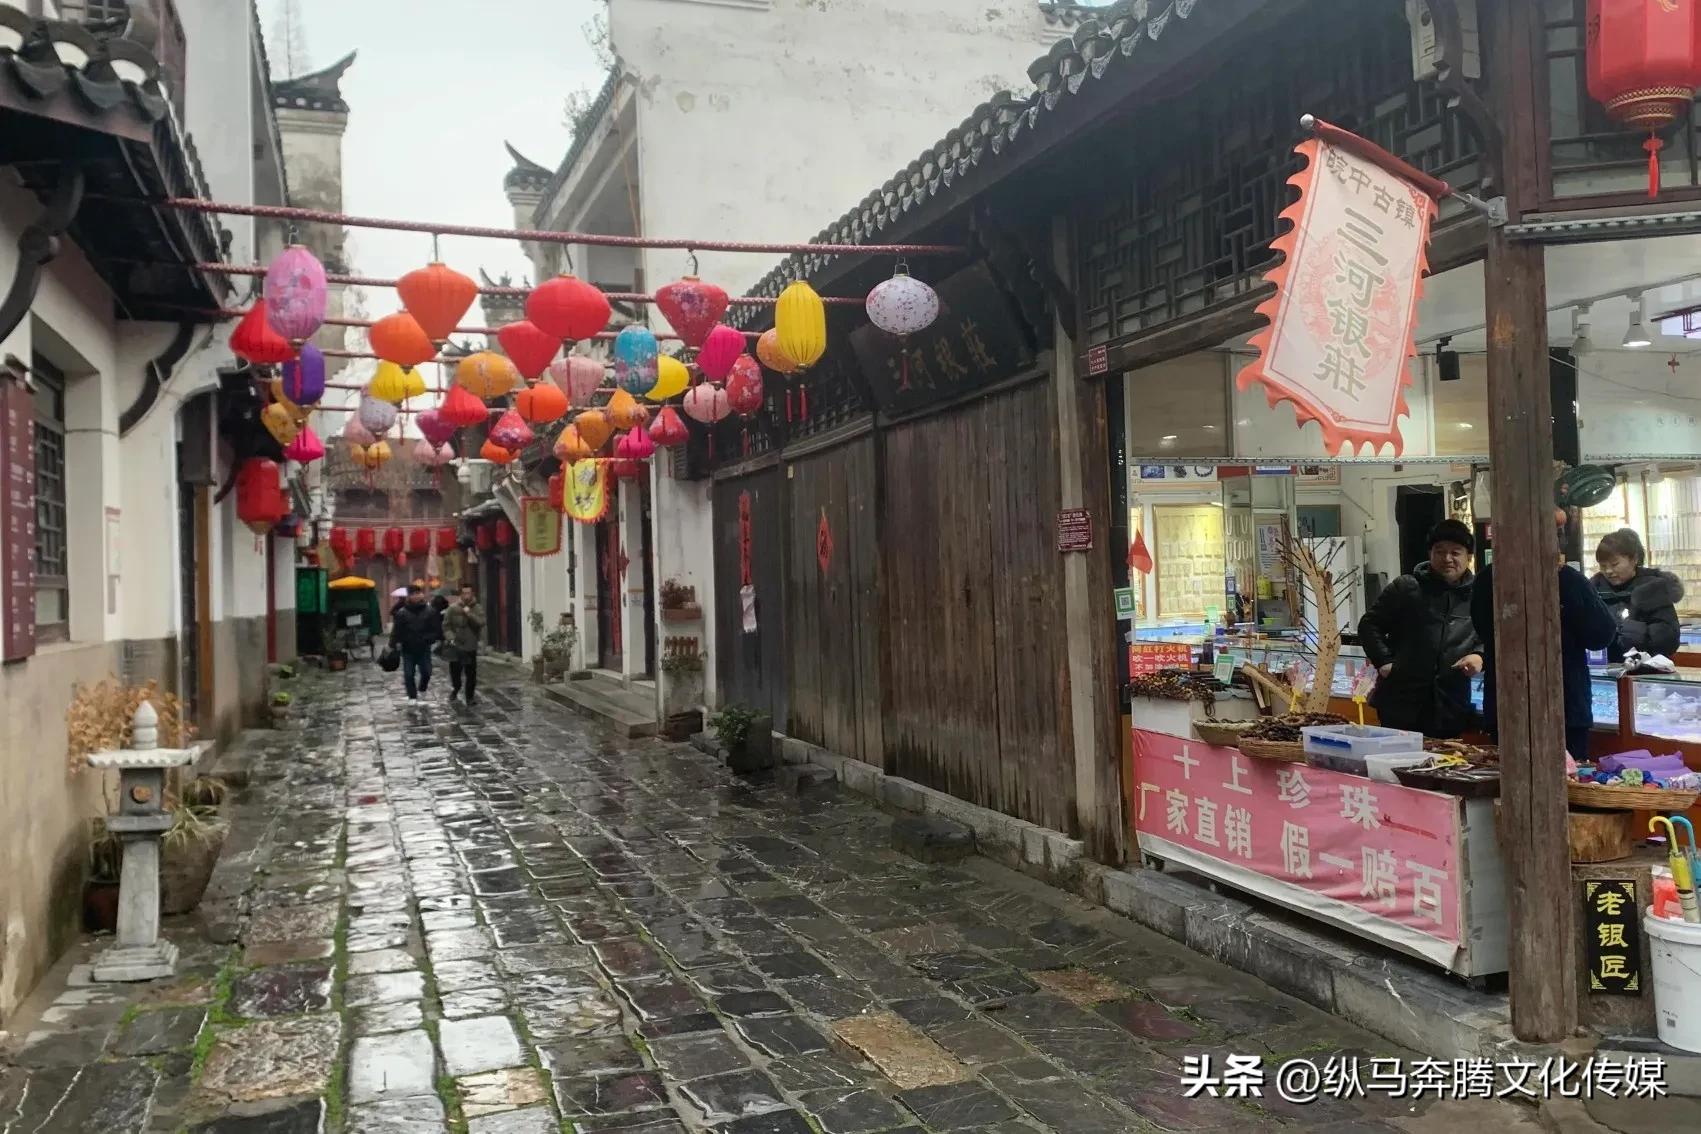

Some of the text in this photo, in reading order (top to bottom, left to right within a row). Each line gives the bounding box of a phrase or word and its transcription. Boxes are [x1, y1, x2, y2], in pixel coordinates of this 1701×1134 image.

[1325, 147, 1417, 231] 皖中古镇
[1138, 781, 1448, 925] 厂家直销 假一赔百
[1597, 890, 1630, 979] 老银匠
